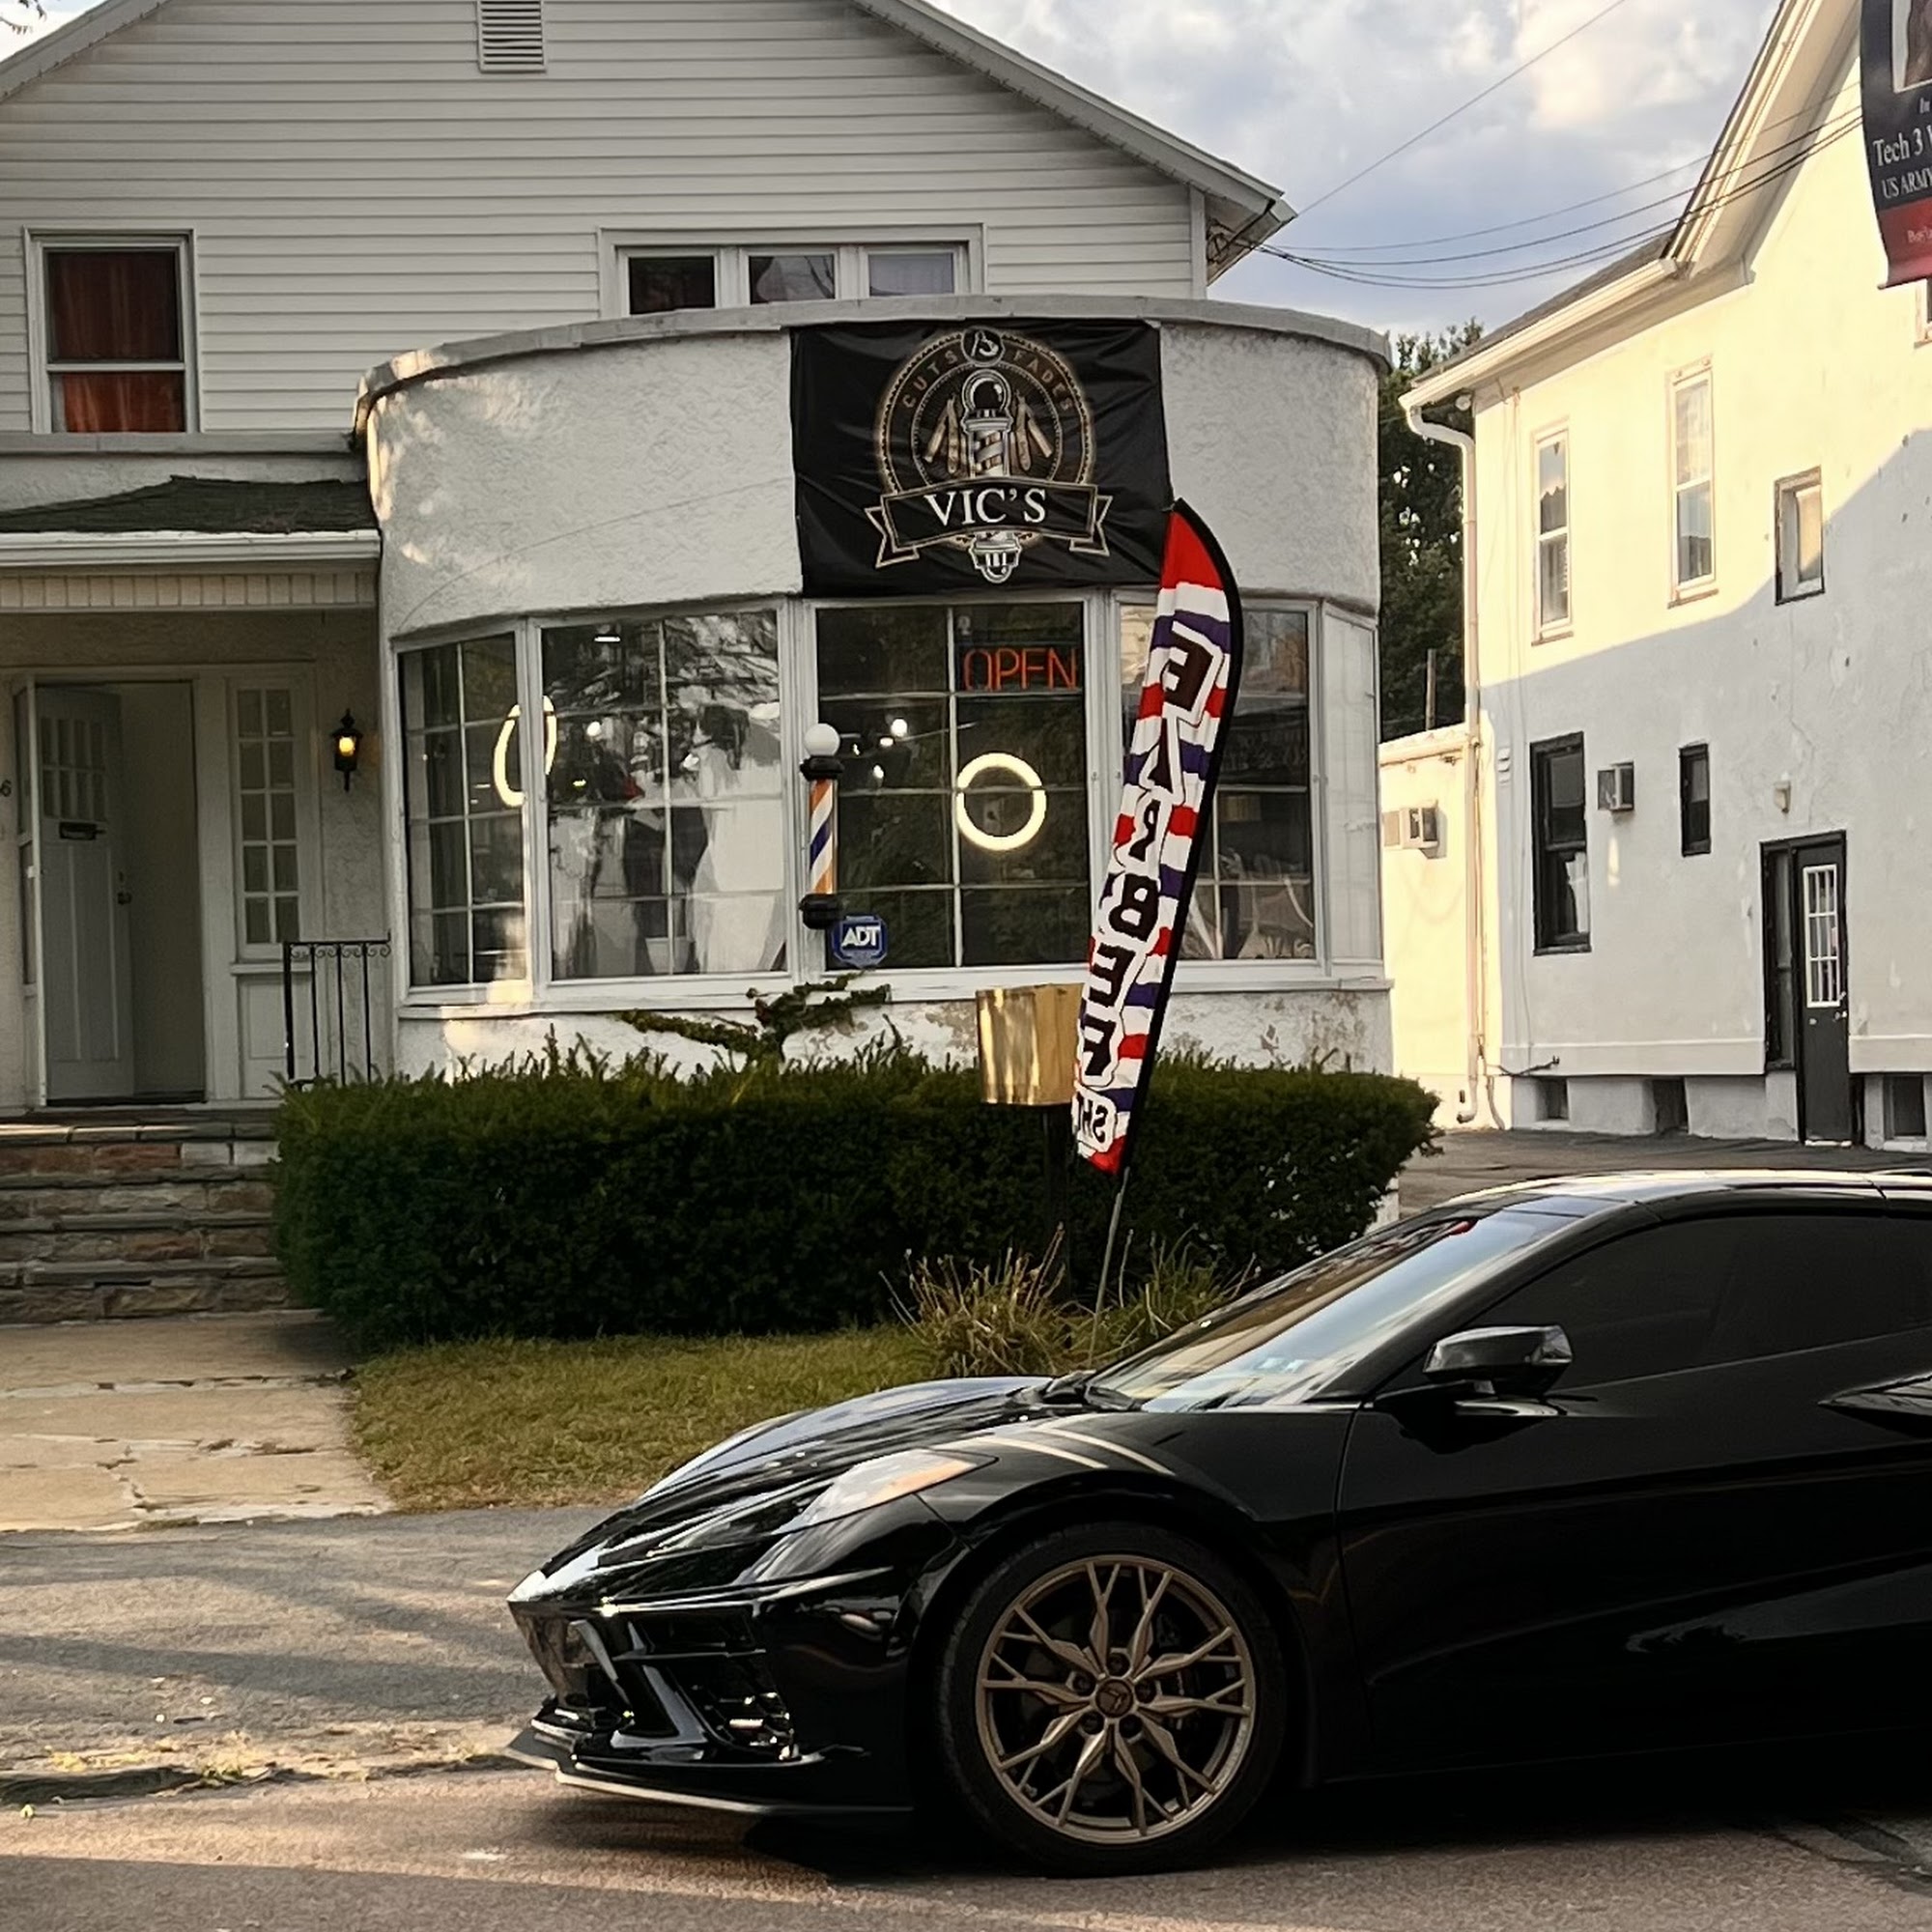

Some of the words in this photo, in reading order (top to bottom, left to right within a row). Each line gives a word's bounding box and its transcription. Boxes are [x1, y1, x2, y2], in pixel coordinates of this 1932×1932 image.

[1873, 132, 1910, 166] Tech
[1913, 128, 1923, 156] 3
[1882, 176, 1900, 199] US
[901, 350, 958, 409] CUTS
[1012, 351, 1074, 411] FADES
[924, 487, 1046, 526] VIC'S
[963, 648, 1078, 692] OPEN
[841, 925, 881, 948] ADT
